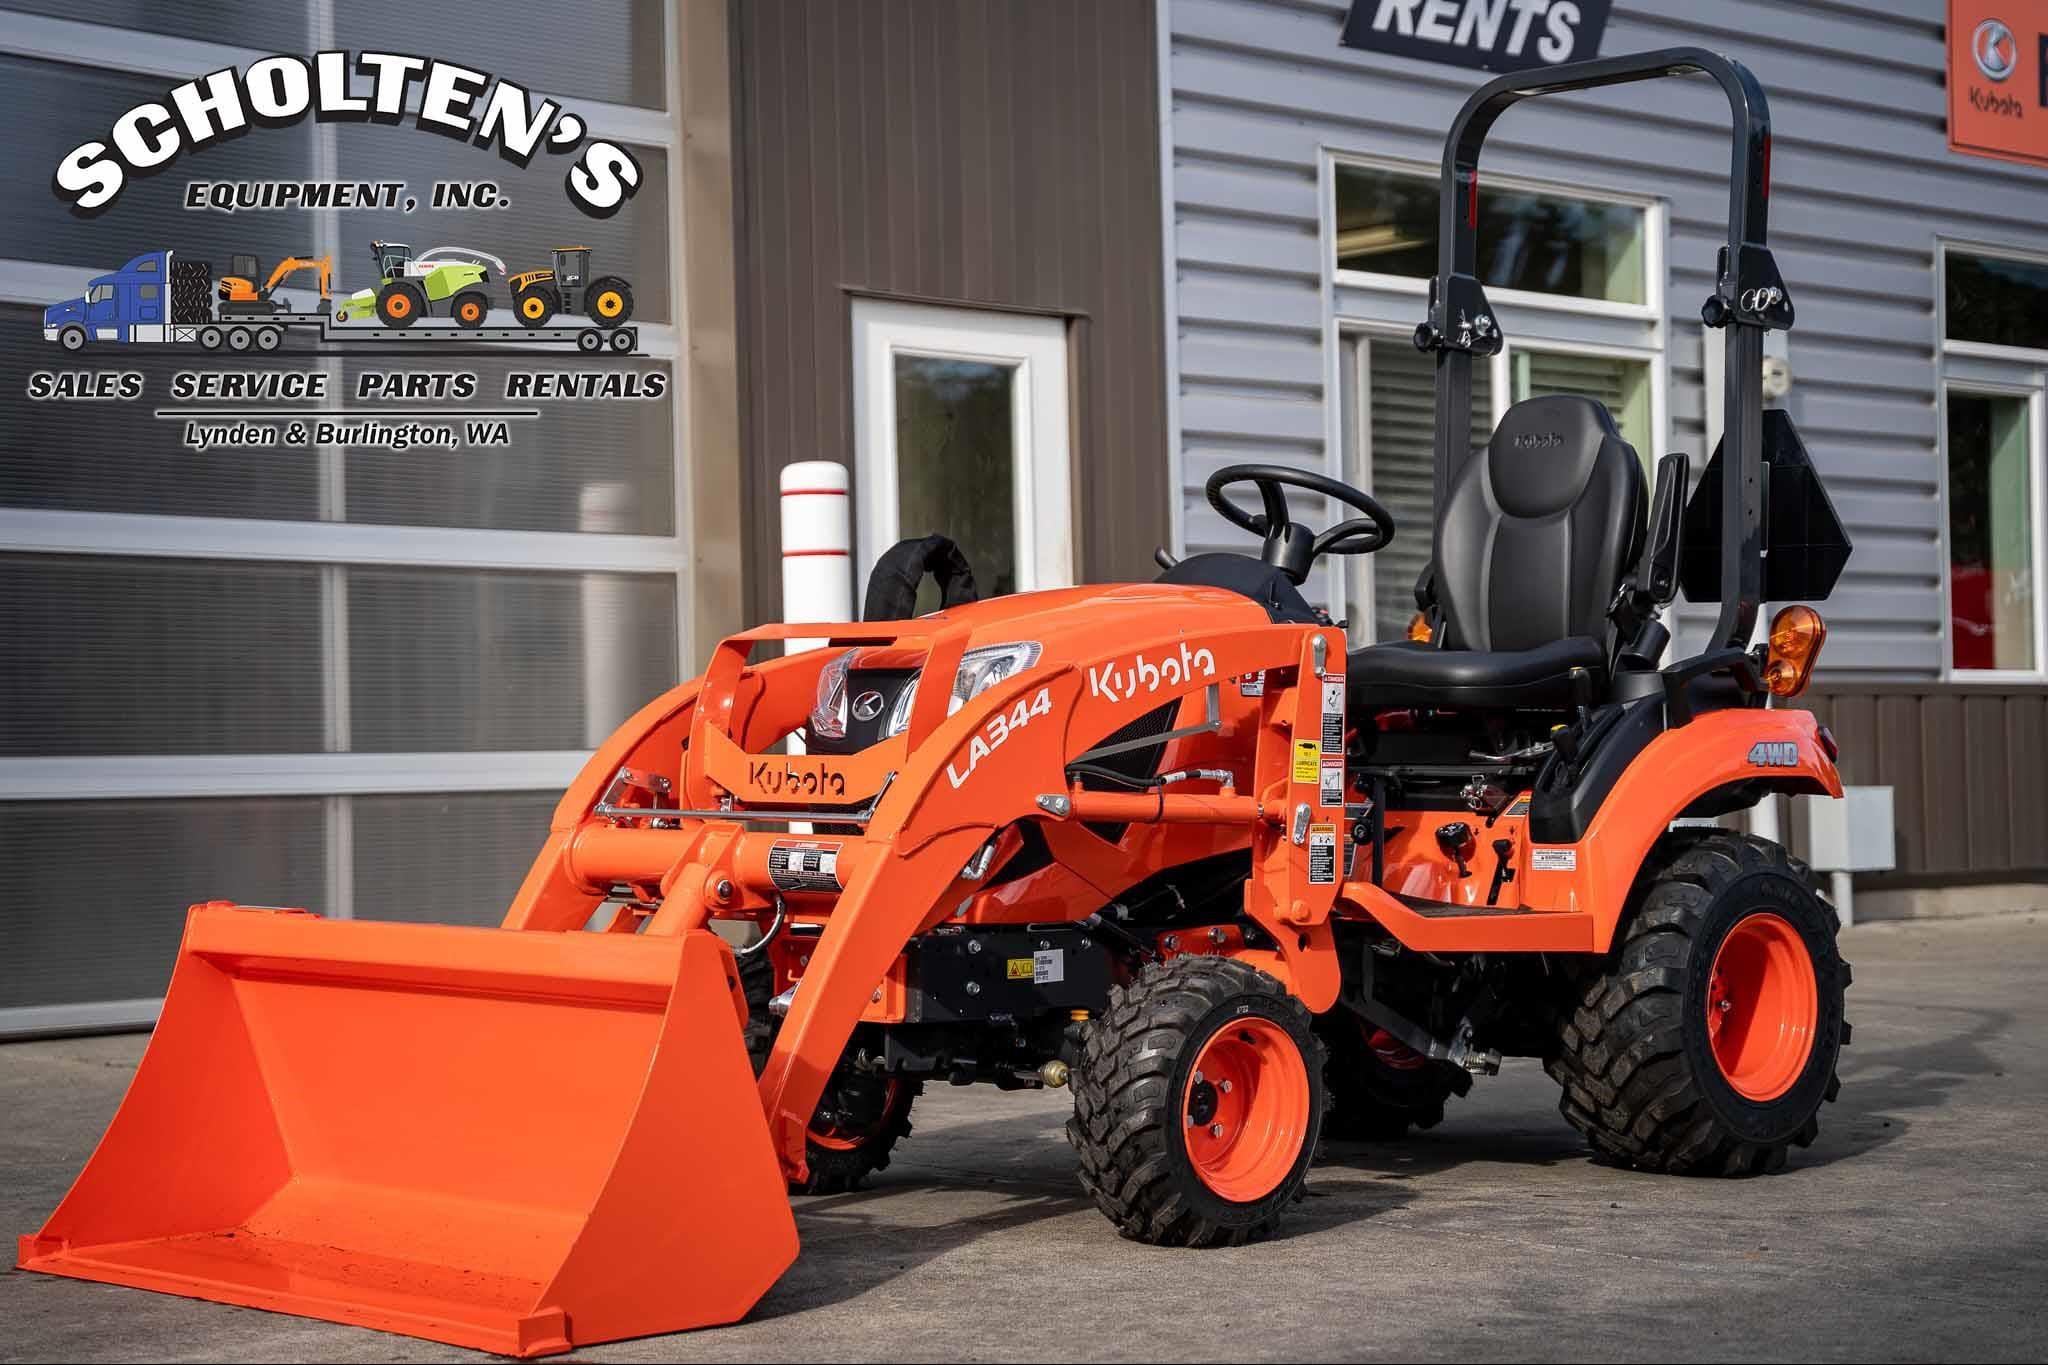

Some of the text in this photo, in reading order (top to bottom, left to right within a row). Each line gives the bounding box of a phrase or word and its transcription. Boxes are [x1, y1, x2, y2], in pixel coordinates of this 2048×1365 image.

[1372, 0, 1581, 64] RENTS
[1969, 86, 2023, 119] Kubota
[1089, 642, 1216, 703] Kubota
[946, 688, 1053, 789] LA344
[1748, 742, 1798, 768] 4WD
[749, 762, 845, 796] Kubota
